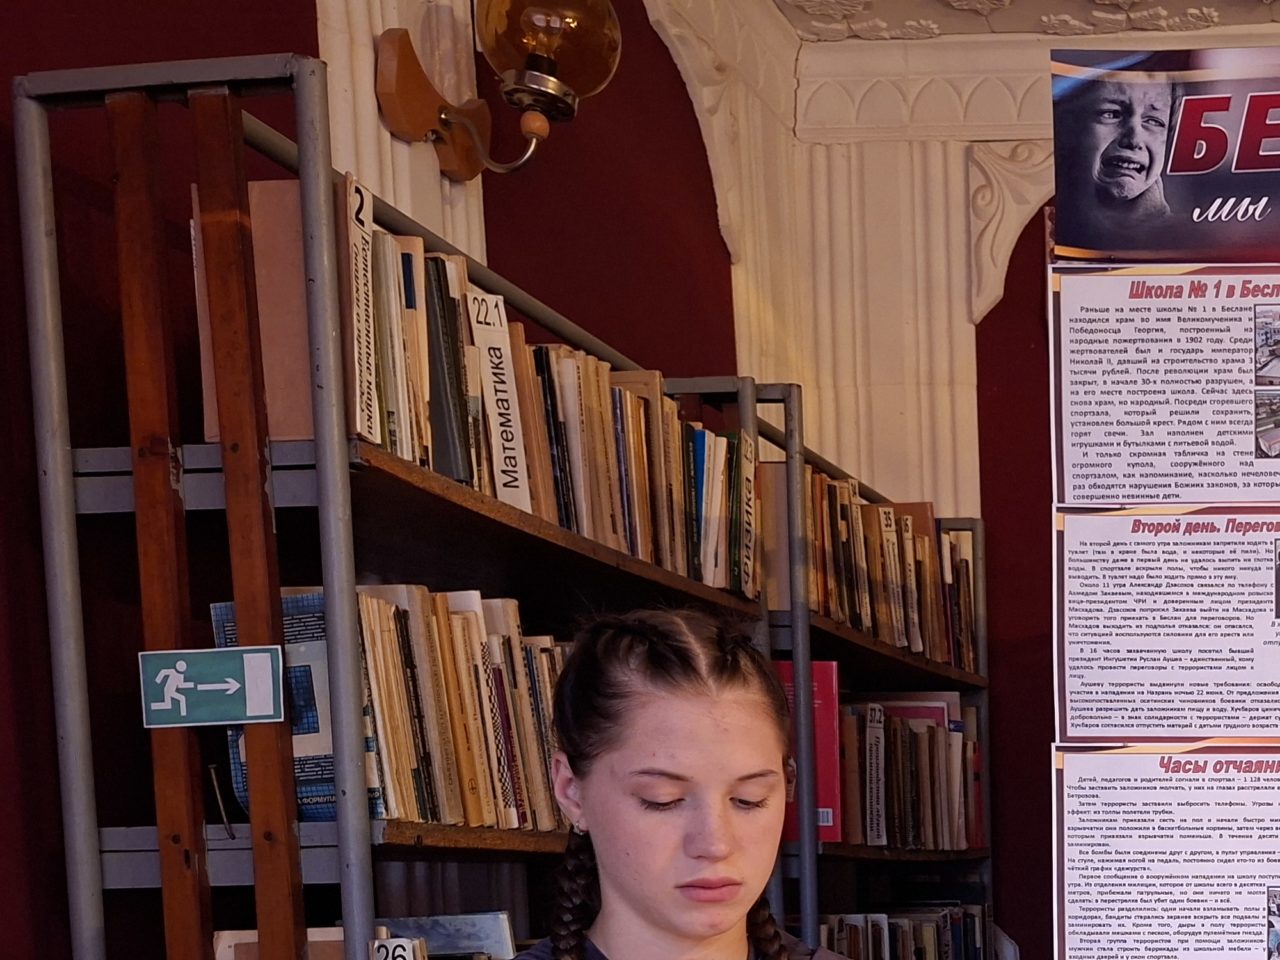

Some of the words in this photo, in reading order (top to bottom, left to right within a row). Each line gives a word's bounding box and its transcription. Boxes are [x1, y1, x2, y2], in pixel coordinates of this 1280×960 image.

[354, 185, 365, 227] 2
[1193, 193, 1272, 223] мы
[1129, 280, 1183, 299] Школа
[361, 236, 373, 377] Естественные
[473, 297, 505, 328] 22.1
[1069, 326, 1120, 334] Победоносца
[1134, 326, 1165, 334] Георгия,
[1179, 326, 1230, 334] построенный
[365, 382, 374, 436] науки
[487, 346, 519, 490] Математика
[742, 476, 754, 588] Физика
[1131, 518, 1180, 536] Второй
[1183, 521, 1220, 536] день.
[868, 707, 883, 725] 37.2
[1159, 756, 1207, 773] Часы
